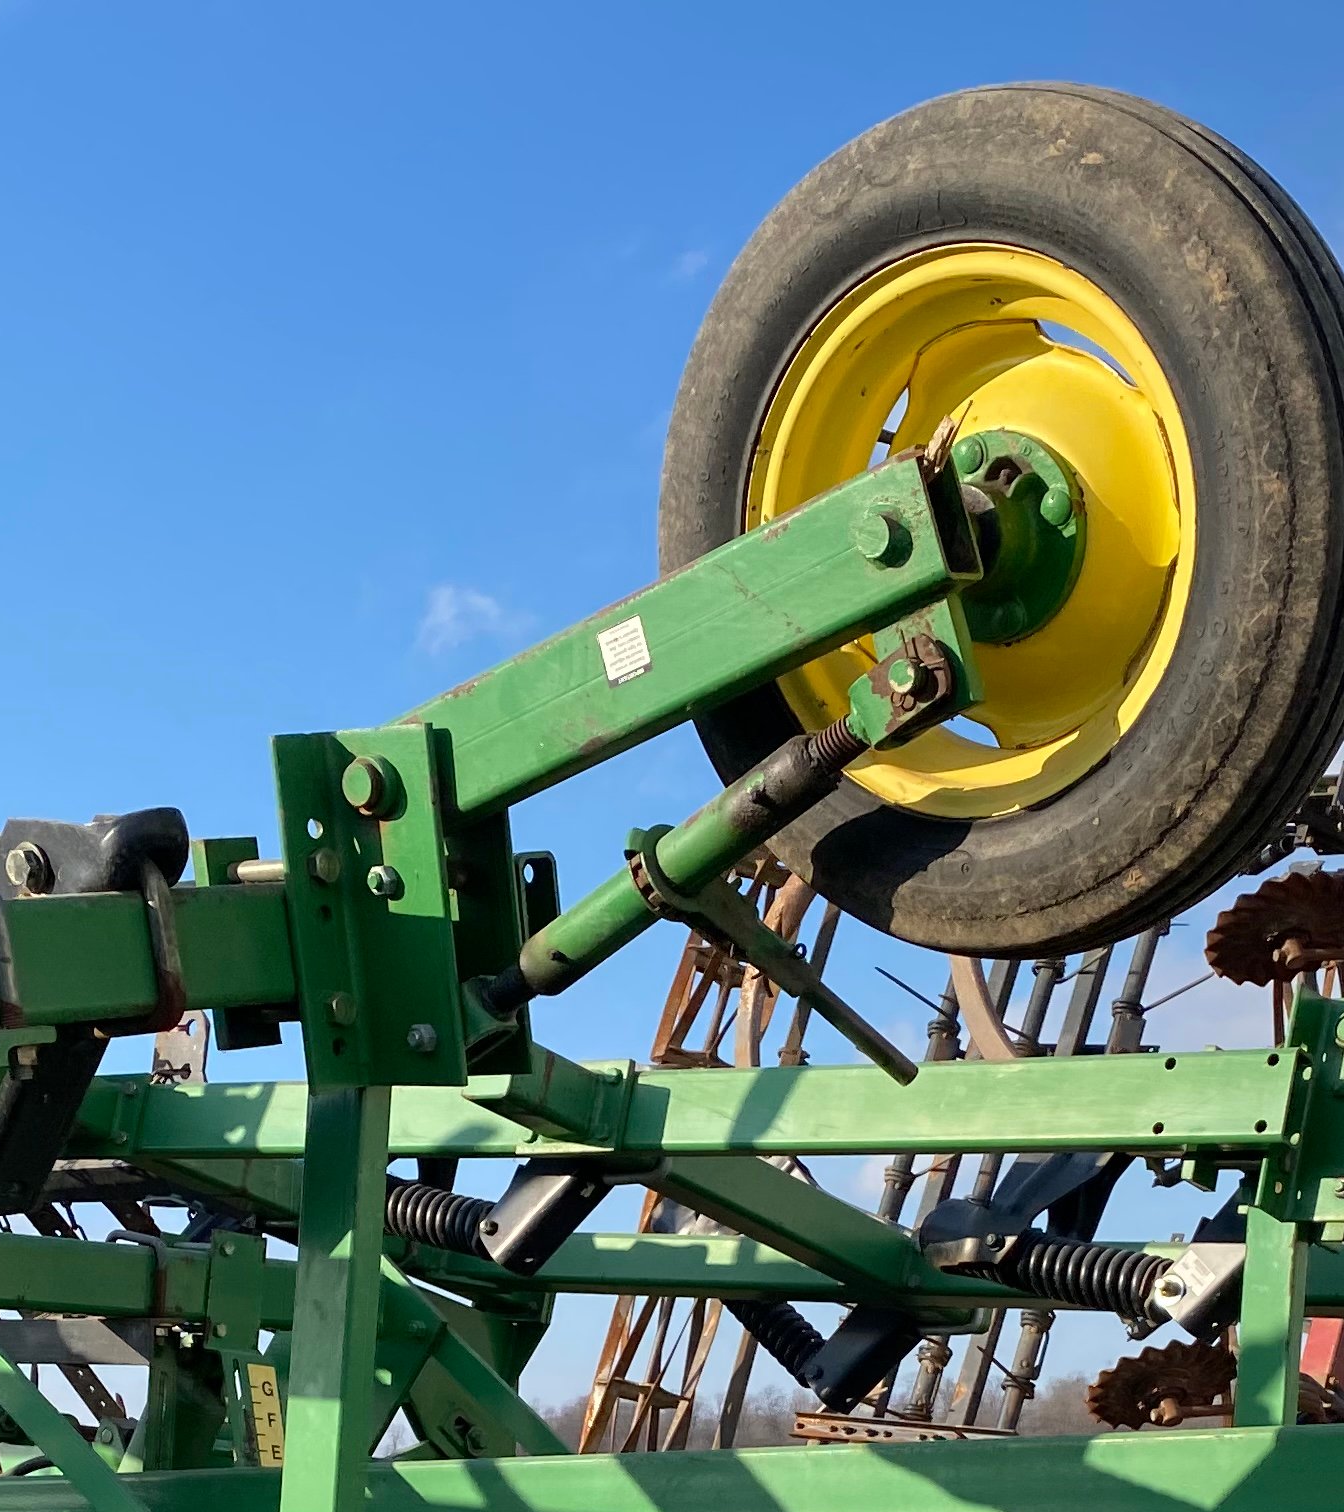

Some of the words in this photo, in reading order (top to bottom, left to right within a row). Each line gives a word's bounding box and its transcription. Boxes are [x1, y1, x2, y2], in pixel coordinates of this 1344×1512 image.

[261, 1380, 274, 1397] G
[267, 1412, 277, 1428] F
[271, 1444, 282, 1461] E
